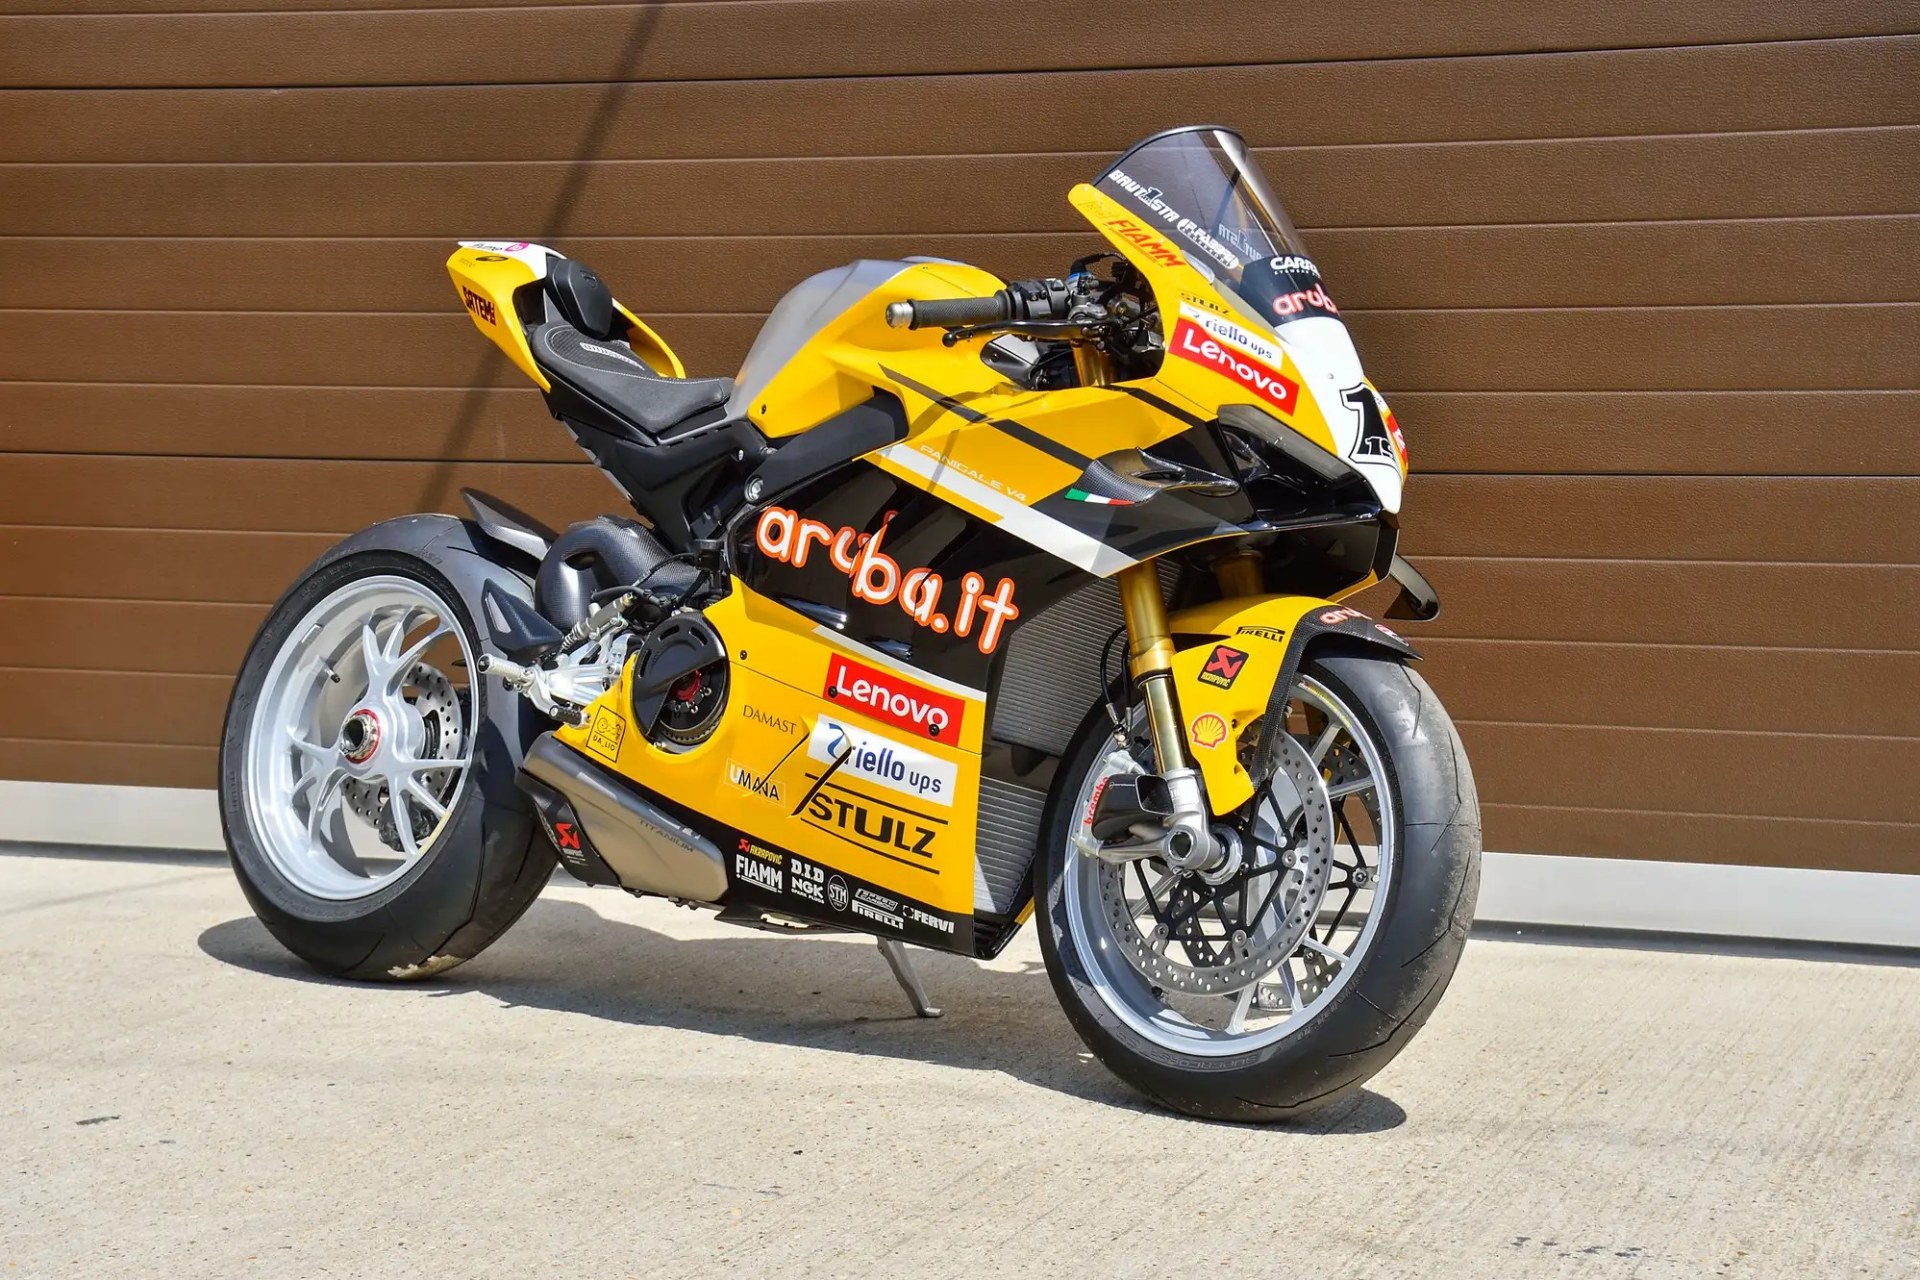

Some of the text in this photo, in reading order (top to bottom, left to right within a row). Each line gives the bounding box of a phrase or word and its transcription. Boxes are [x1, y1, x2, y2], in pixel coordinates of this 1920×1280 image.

[1107, 219, 1187, 268] FIAMM
[1204, 318, 1273, 360] riello ups
[1182, 327, 1288, 400] Lenovo
[1006, 486, 1027, 502] V4
[756, 506, 1019, 655] aruba.it
[1236, 626, 1286, 643] PIRELLI
[835, 665, 949, 731] Lenovo
[743, 704, 797, 735] DAMAST
[909, 771, 942, 794] ups
[639, 818, 695, 852] TITANIUM
[808, 791, 936, 859] STULZ
[735, 853, 783, 890] FIAMM
[791, 876, 824, 899] NGK
[828, 883, 847, 903] STM
[851, 899, 904, 930] PIRELLI
[914, 908, 954, 934] FERVI
